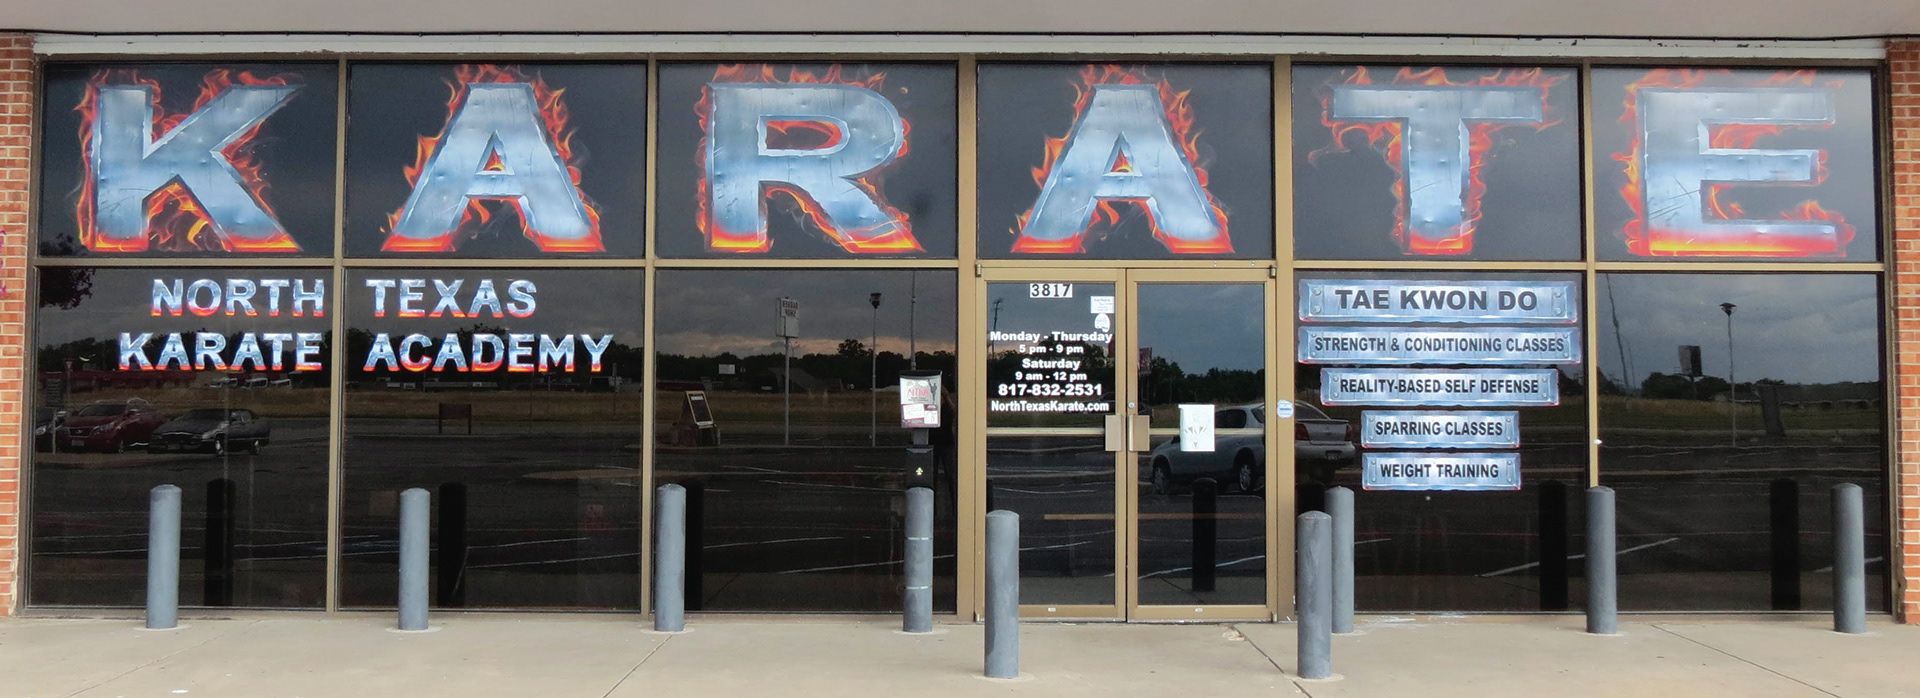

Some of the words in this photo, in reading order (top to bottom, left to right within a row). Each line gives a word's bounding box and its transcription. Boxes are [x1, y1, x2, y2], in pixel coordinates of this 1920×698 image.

[88, 82, 1841, 257] KARATE
[1031, 284, 1070, 296] 3817
[151, 278, 325, 318] NORTH
[366, 278, 538, 318] TEXAS
[1334, 289, 1390, 309] TAE
[1400, 289, 1488, 310] KWON
[1498, 290, 1538, 311] DO
[990, 332, 1040, 344] Monday
[1052, 331, 1113, 344] Thursday
[1314, 337, 1386, 351] STRENGTH
[1390, 337, 1400, 351] &
[1404, 337, 1501, 352] CONDITIONING
[1506, 337, 1565, 352] CLASSES
[118, 332, 323, 371] KARATE
[363, 332, 615, 373] ACADEMY
[1019, 345, 1026, 353] 5
[1028, 346, 1047, 355] pm
[1056, 344, 1064, 353] 9
[1066, 346, 1084, 355] pm
[1021, 358, 1081, 371] Saturday
[1015, 372, 1023, 381] 9
[1025, 373, 1043, 381] am
[1053, 371, 1067, 381] 12
[1069, 373, 1087, 383] pm
[998, 383, 1103, 396] 817-832-2531
[1340, 379, 1441, 394] REALITY-BASED
[1444, 379, 1477, 393] SELF
[1480, 379, 1539, 394] DEFENSE
[990, 400, 1109, 413] NorthTexasKarate.com
[1375, 421, 1441, 436] SPARRING
[1444, 421, 1503, 436] CLASSES
[1380, 464, 1433, 478] WEIGHT
[1436, 464, 1499, 478] TRAINING
